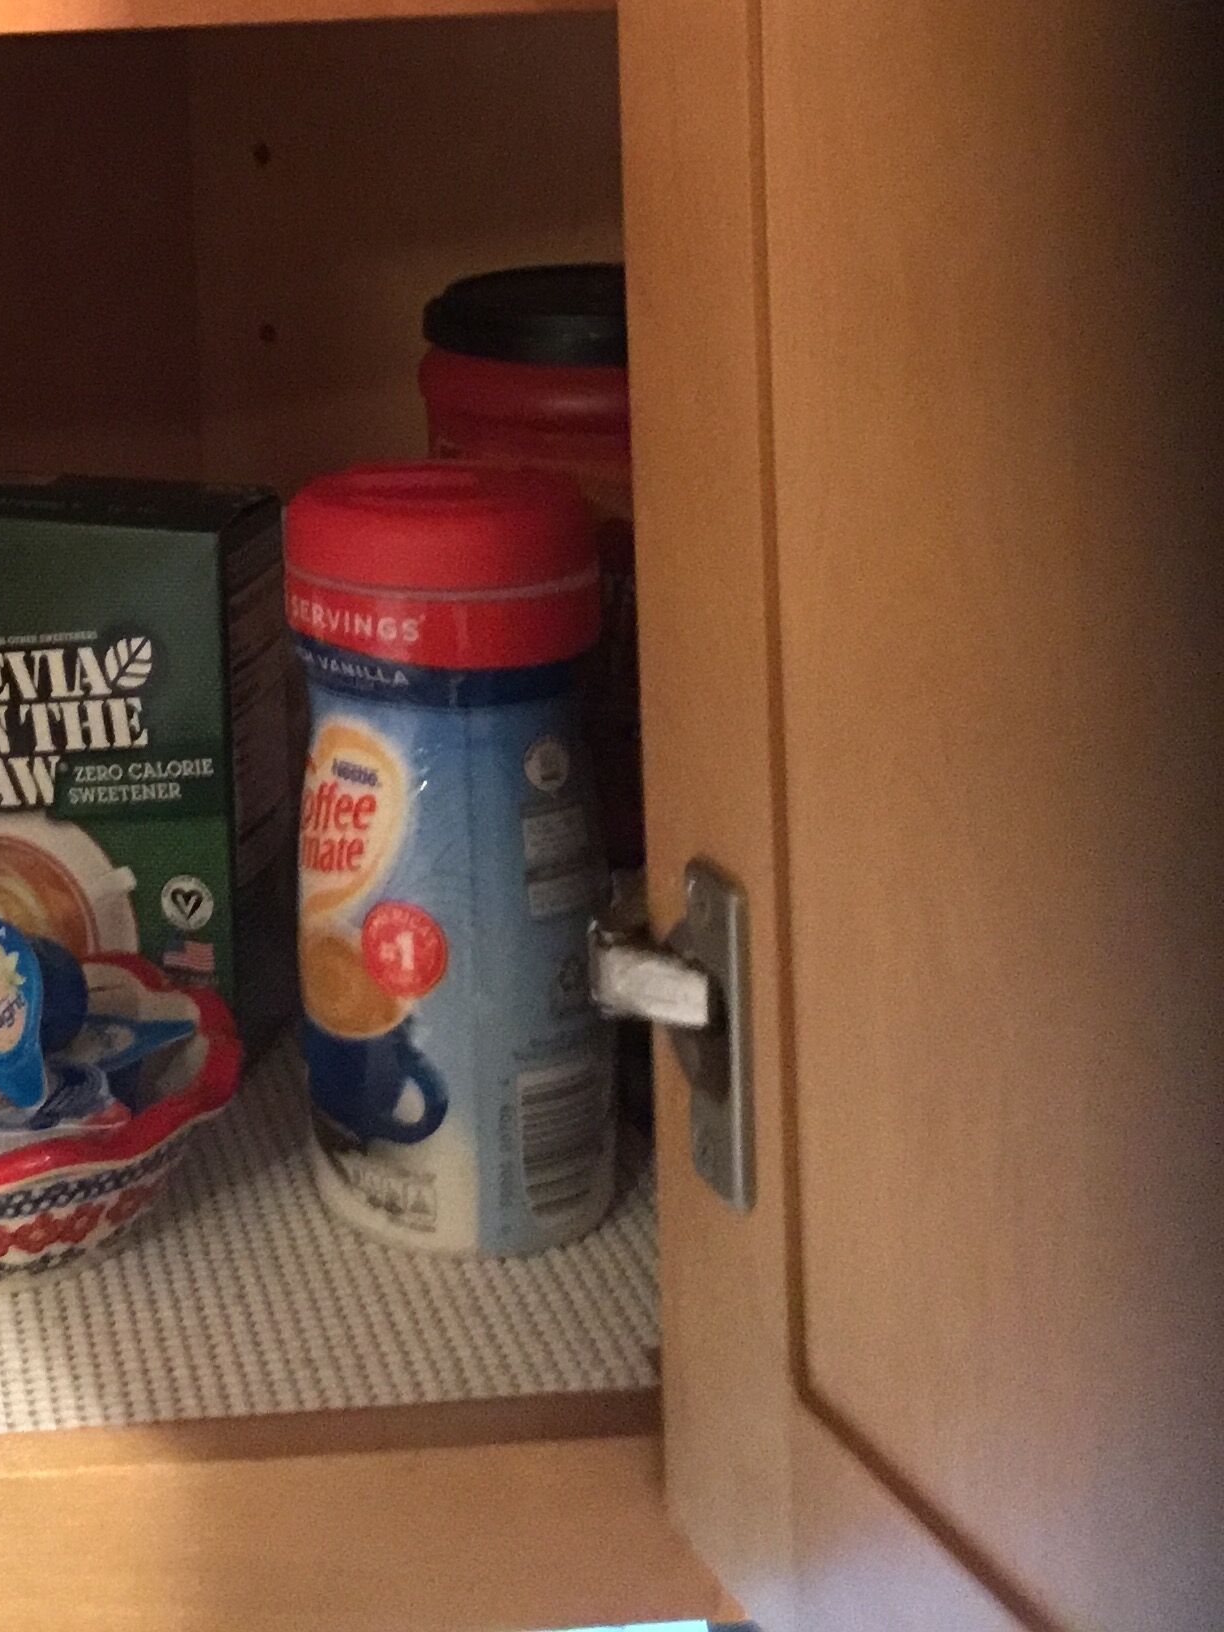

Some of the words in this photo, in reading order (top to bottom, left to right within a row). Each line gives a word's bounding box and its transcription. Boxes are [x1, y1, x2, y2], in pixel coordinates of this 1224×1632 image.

[20, 697, 148, 752] THE
[74, 763, 123, 783] ZERO
[128, 758, 214, 781] CALORIE
[68, 782, 182, 805] SWEETENER
[301, 780, 376, 831] offee
